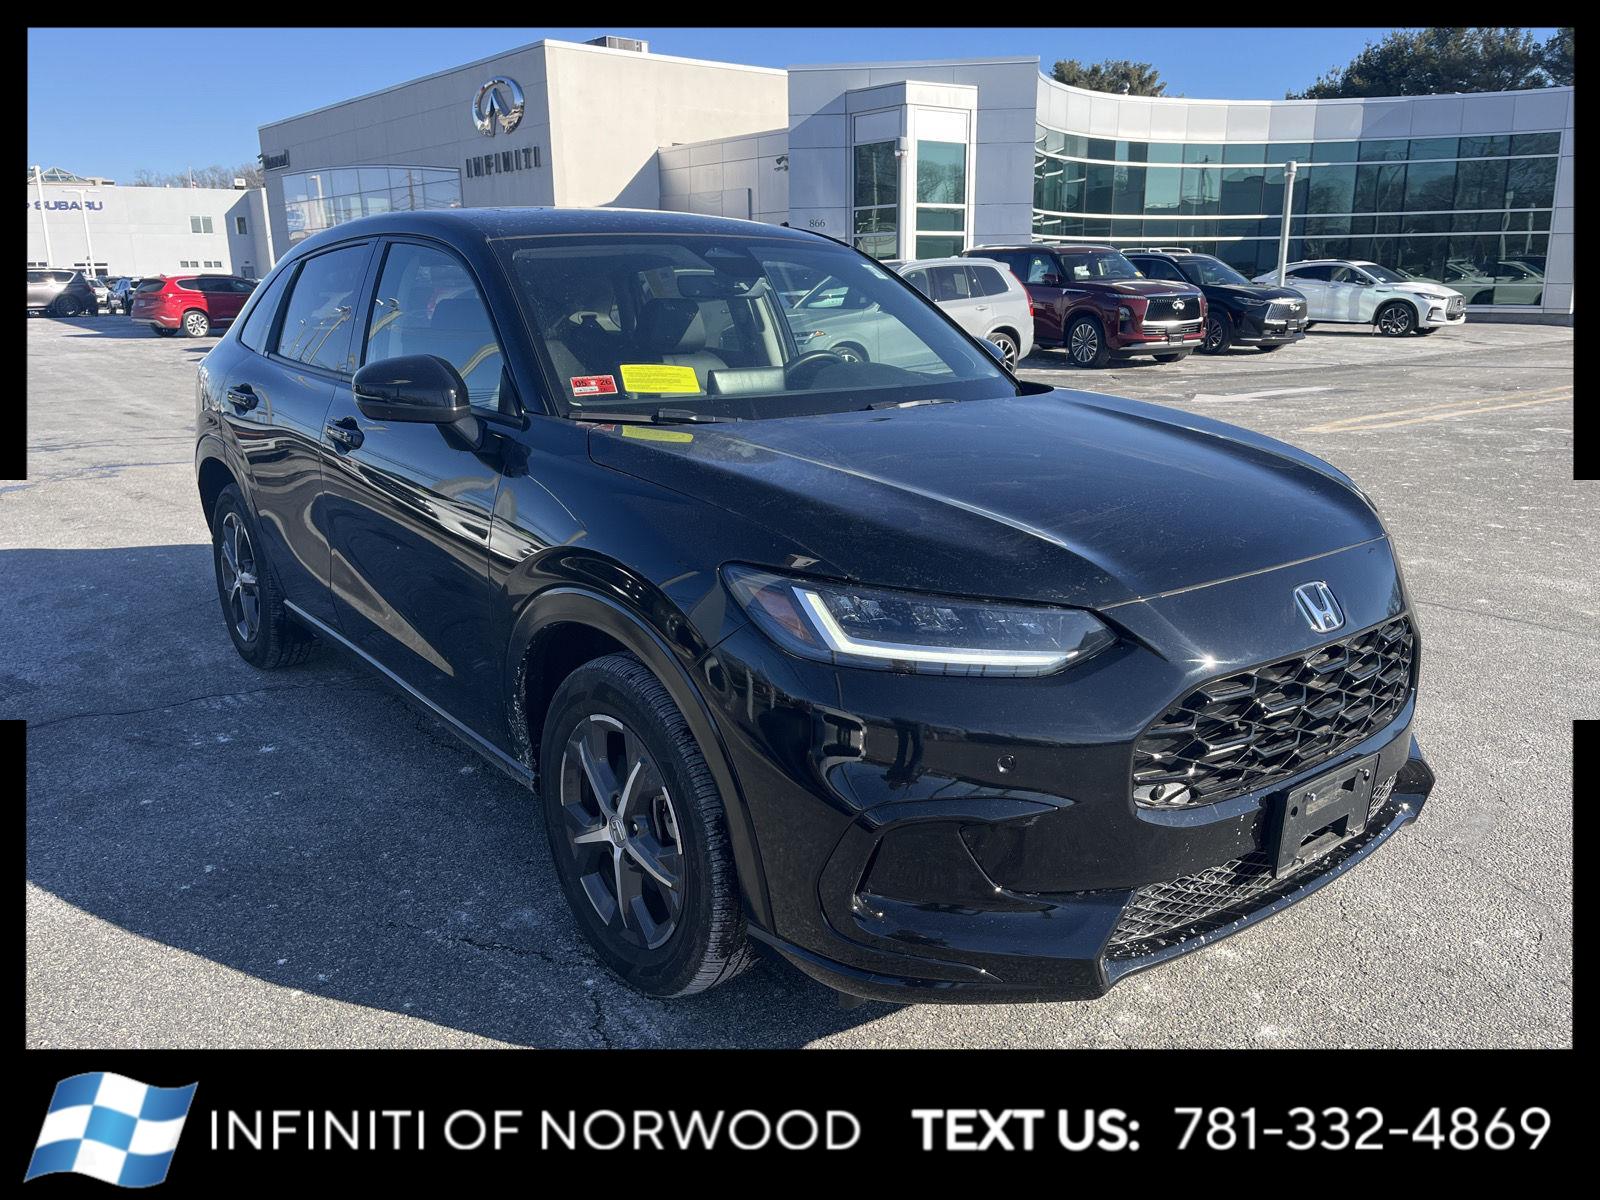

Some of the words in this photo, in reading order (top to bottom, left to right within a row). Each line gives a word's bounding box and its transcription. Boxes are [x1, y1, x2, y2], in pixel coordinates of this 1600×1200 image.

[465, 145, 541, 179] INFINITI
[34, 200, 103, 211] SUBARU
[808, 219, 826, 228] 866
